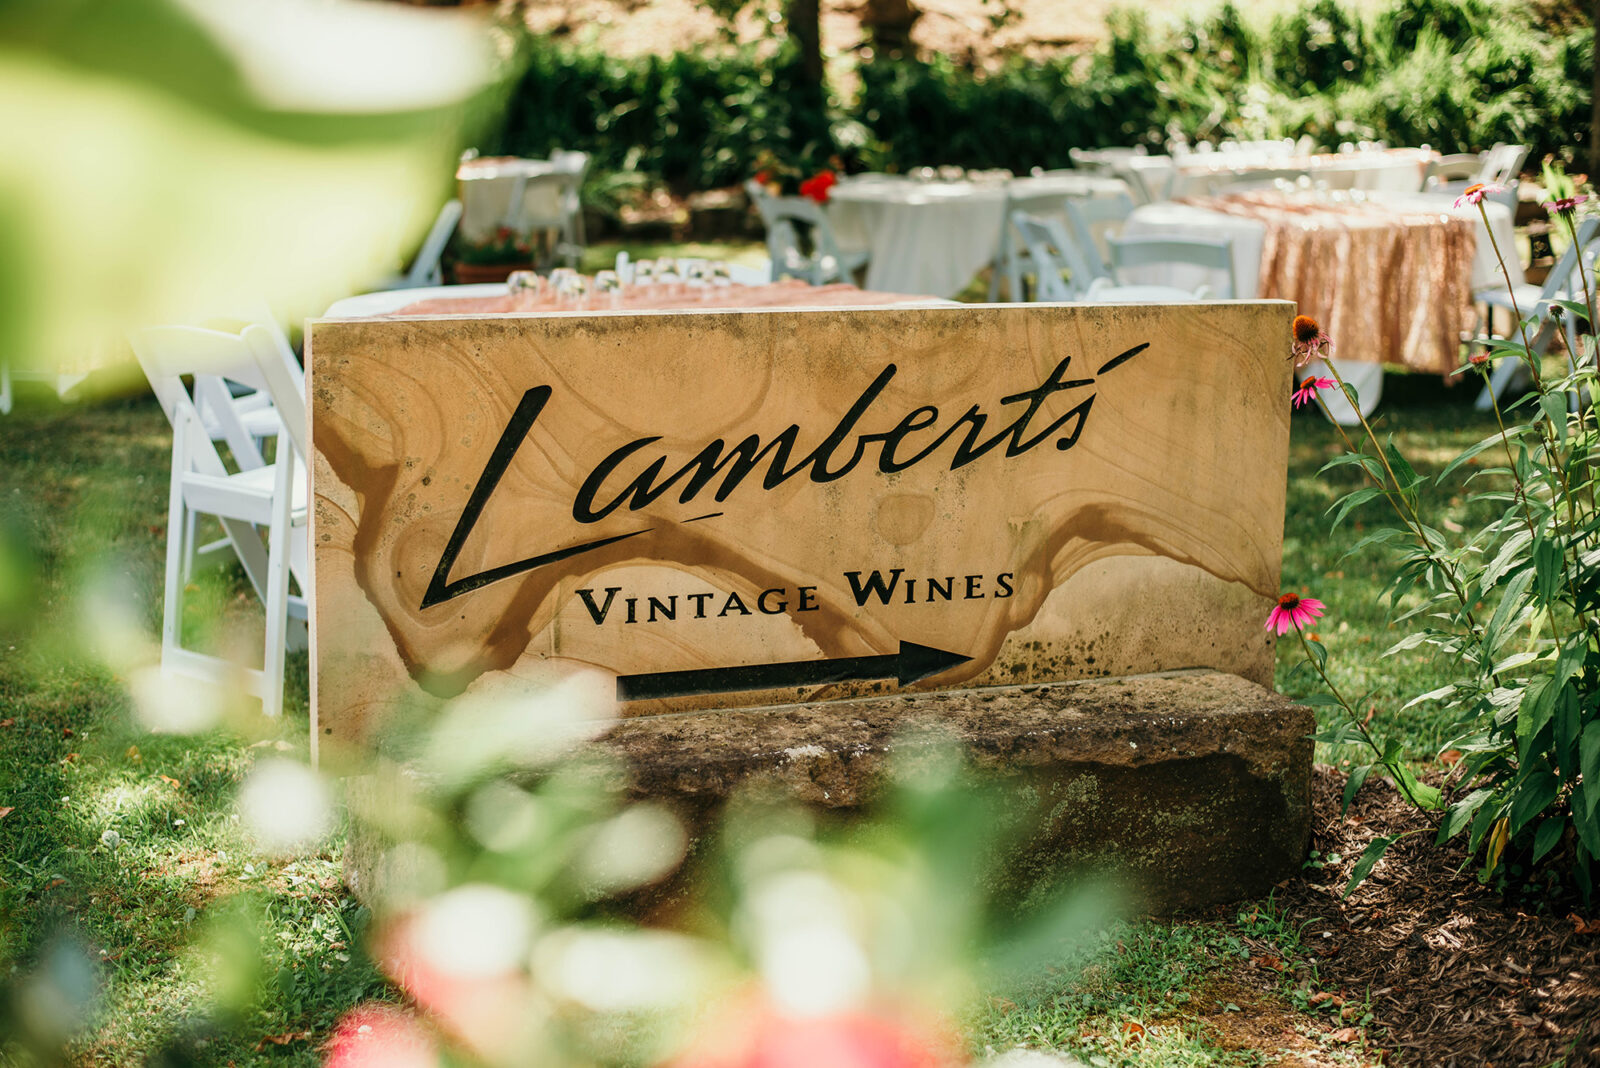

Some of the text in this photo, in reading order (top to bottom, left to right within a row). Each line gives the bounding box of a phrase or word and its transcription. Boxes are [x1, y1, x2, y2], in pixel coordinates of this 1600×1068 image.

[420, 342, 1150, 611] Lambert's
[574, 568, 1015, 626] VINTAGE WINES
